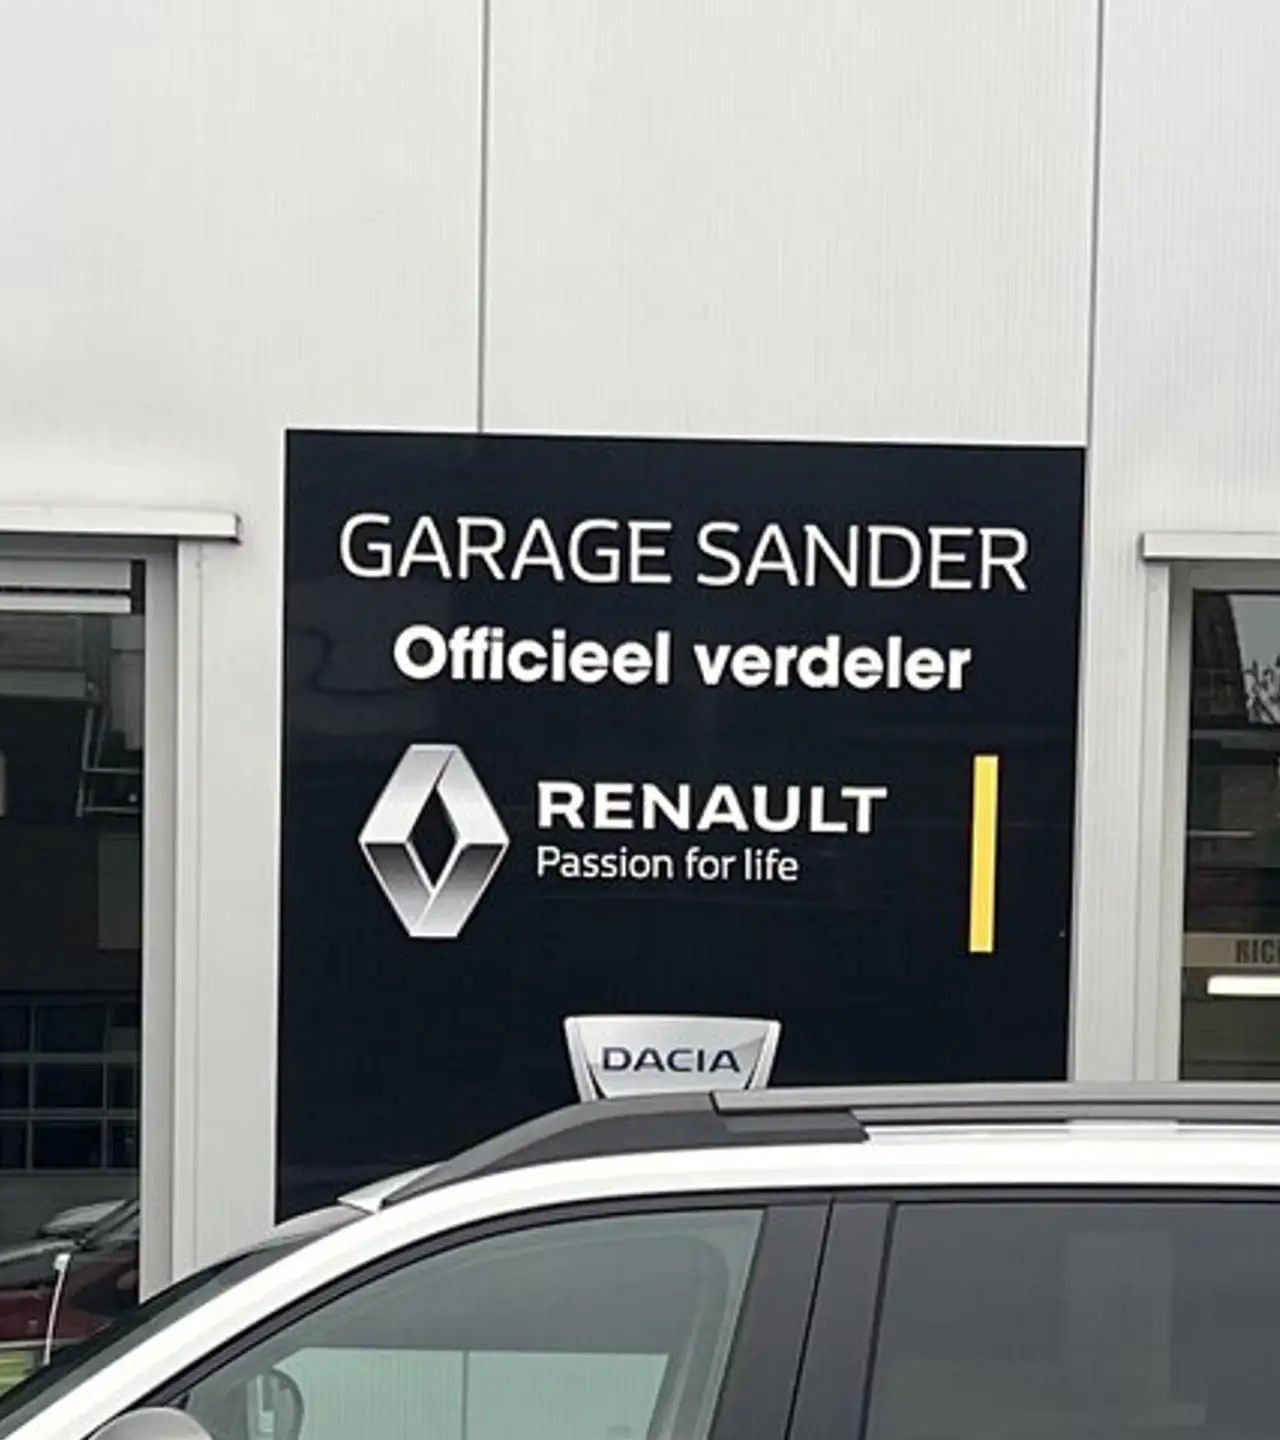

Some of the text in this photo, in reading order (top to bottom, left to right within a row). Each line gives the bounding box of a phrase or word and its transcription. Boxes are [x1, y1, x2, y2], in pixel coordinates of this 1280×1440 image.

[340, 512, 1028, 591] GARAGE SANDER
[393, 624, 972, 691] Officieel verdeler
[537, 781, 888, 834] RENAULT
[537, 845, 799, 882] Passion for life
[602, 1046, 742, 1074] DACIA
